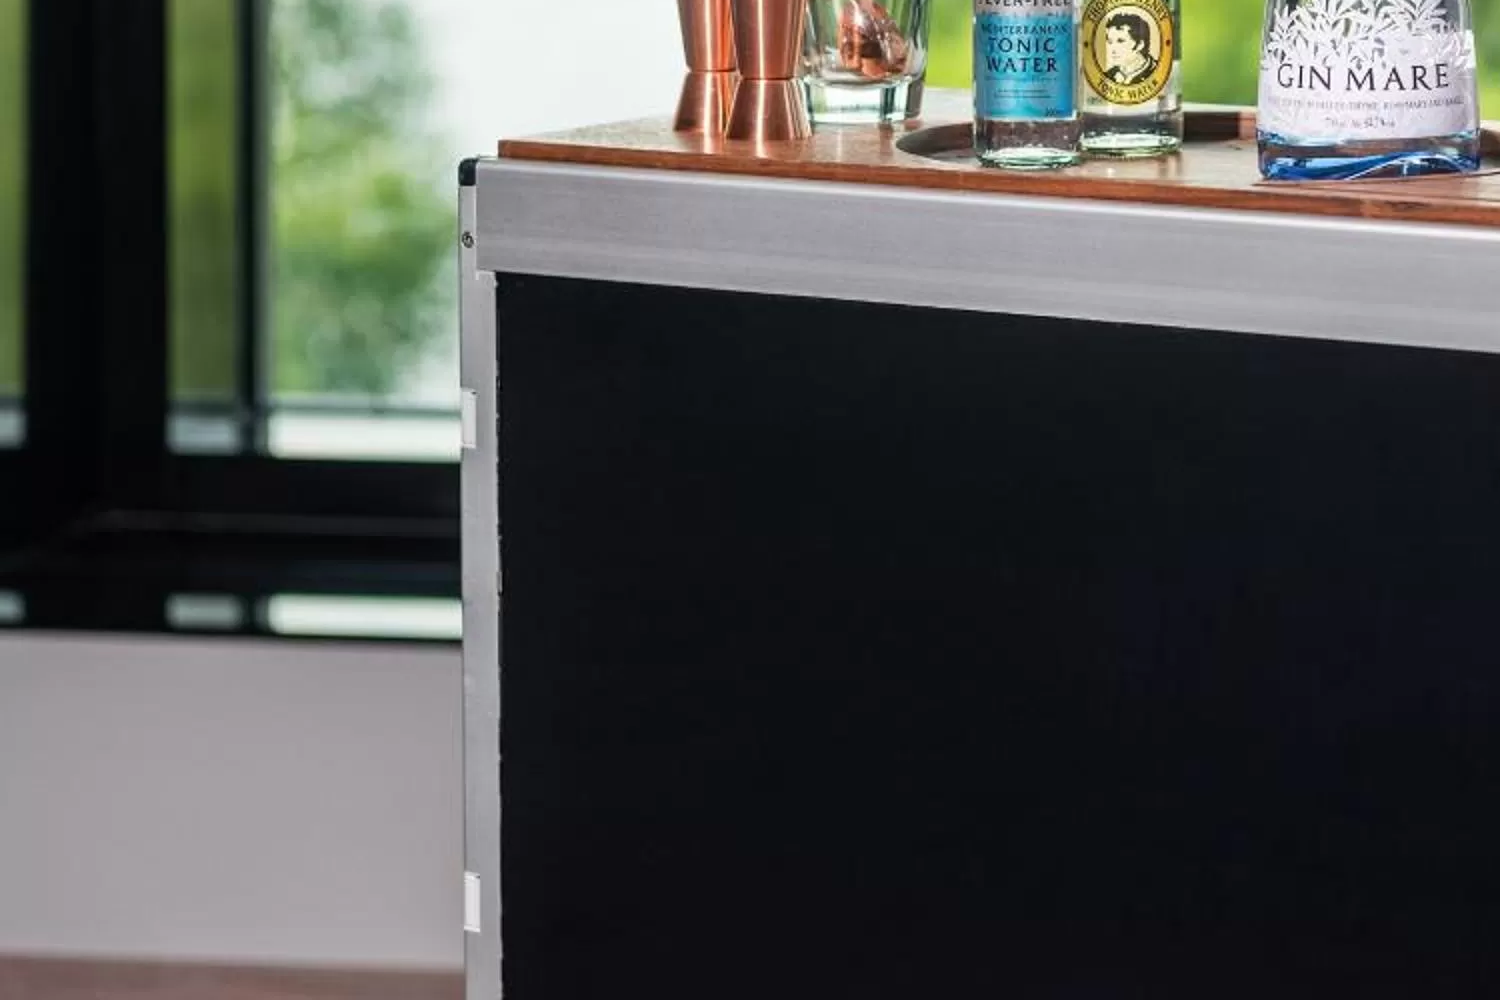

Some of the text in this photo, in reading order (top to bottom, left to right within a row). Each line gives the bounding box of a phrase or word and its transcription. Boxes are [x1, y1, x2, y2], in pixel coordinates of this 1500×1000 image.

[988, 37, 1057, 53] TONIC
[985, 56, 1059, 73] WATER
[1277, 63, 1450, 91] GIN MARE
